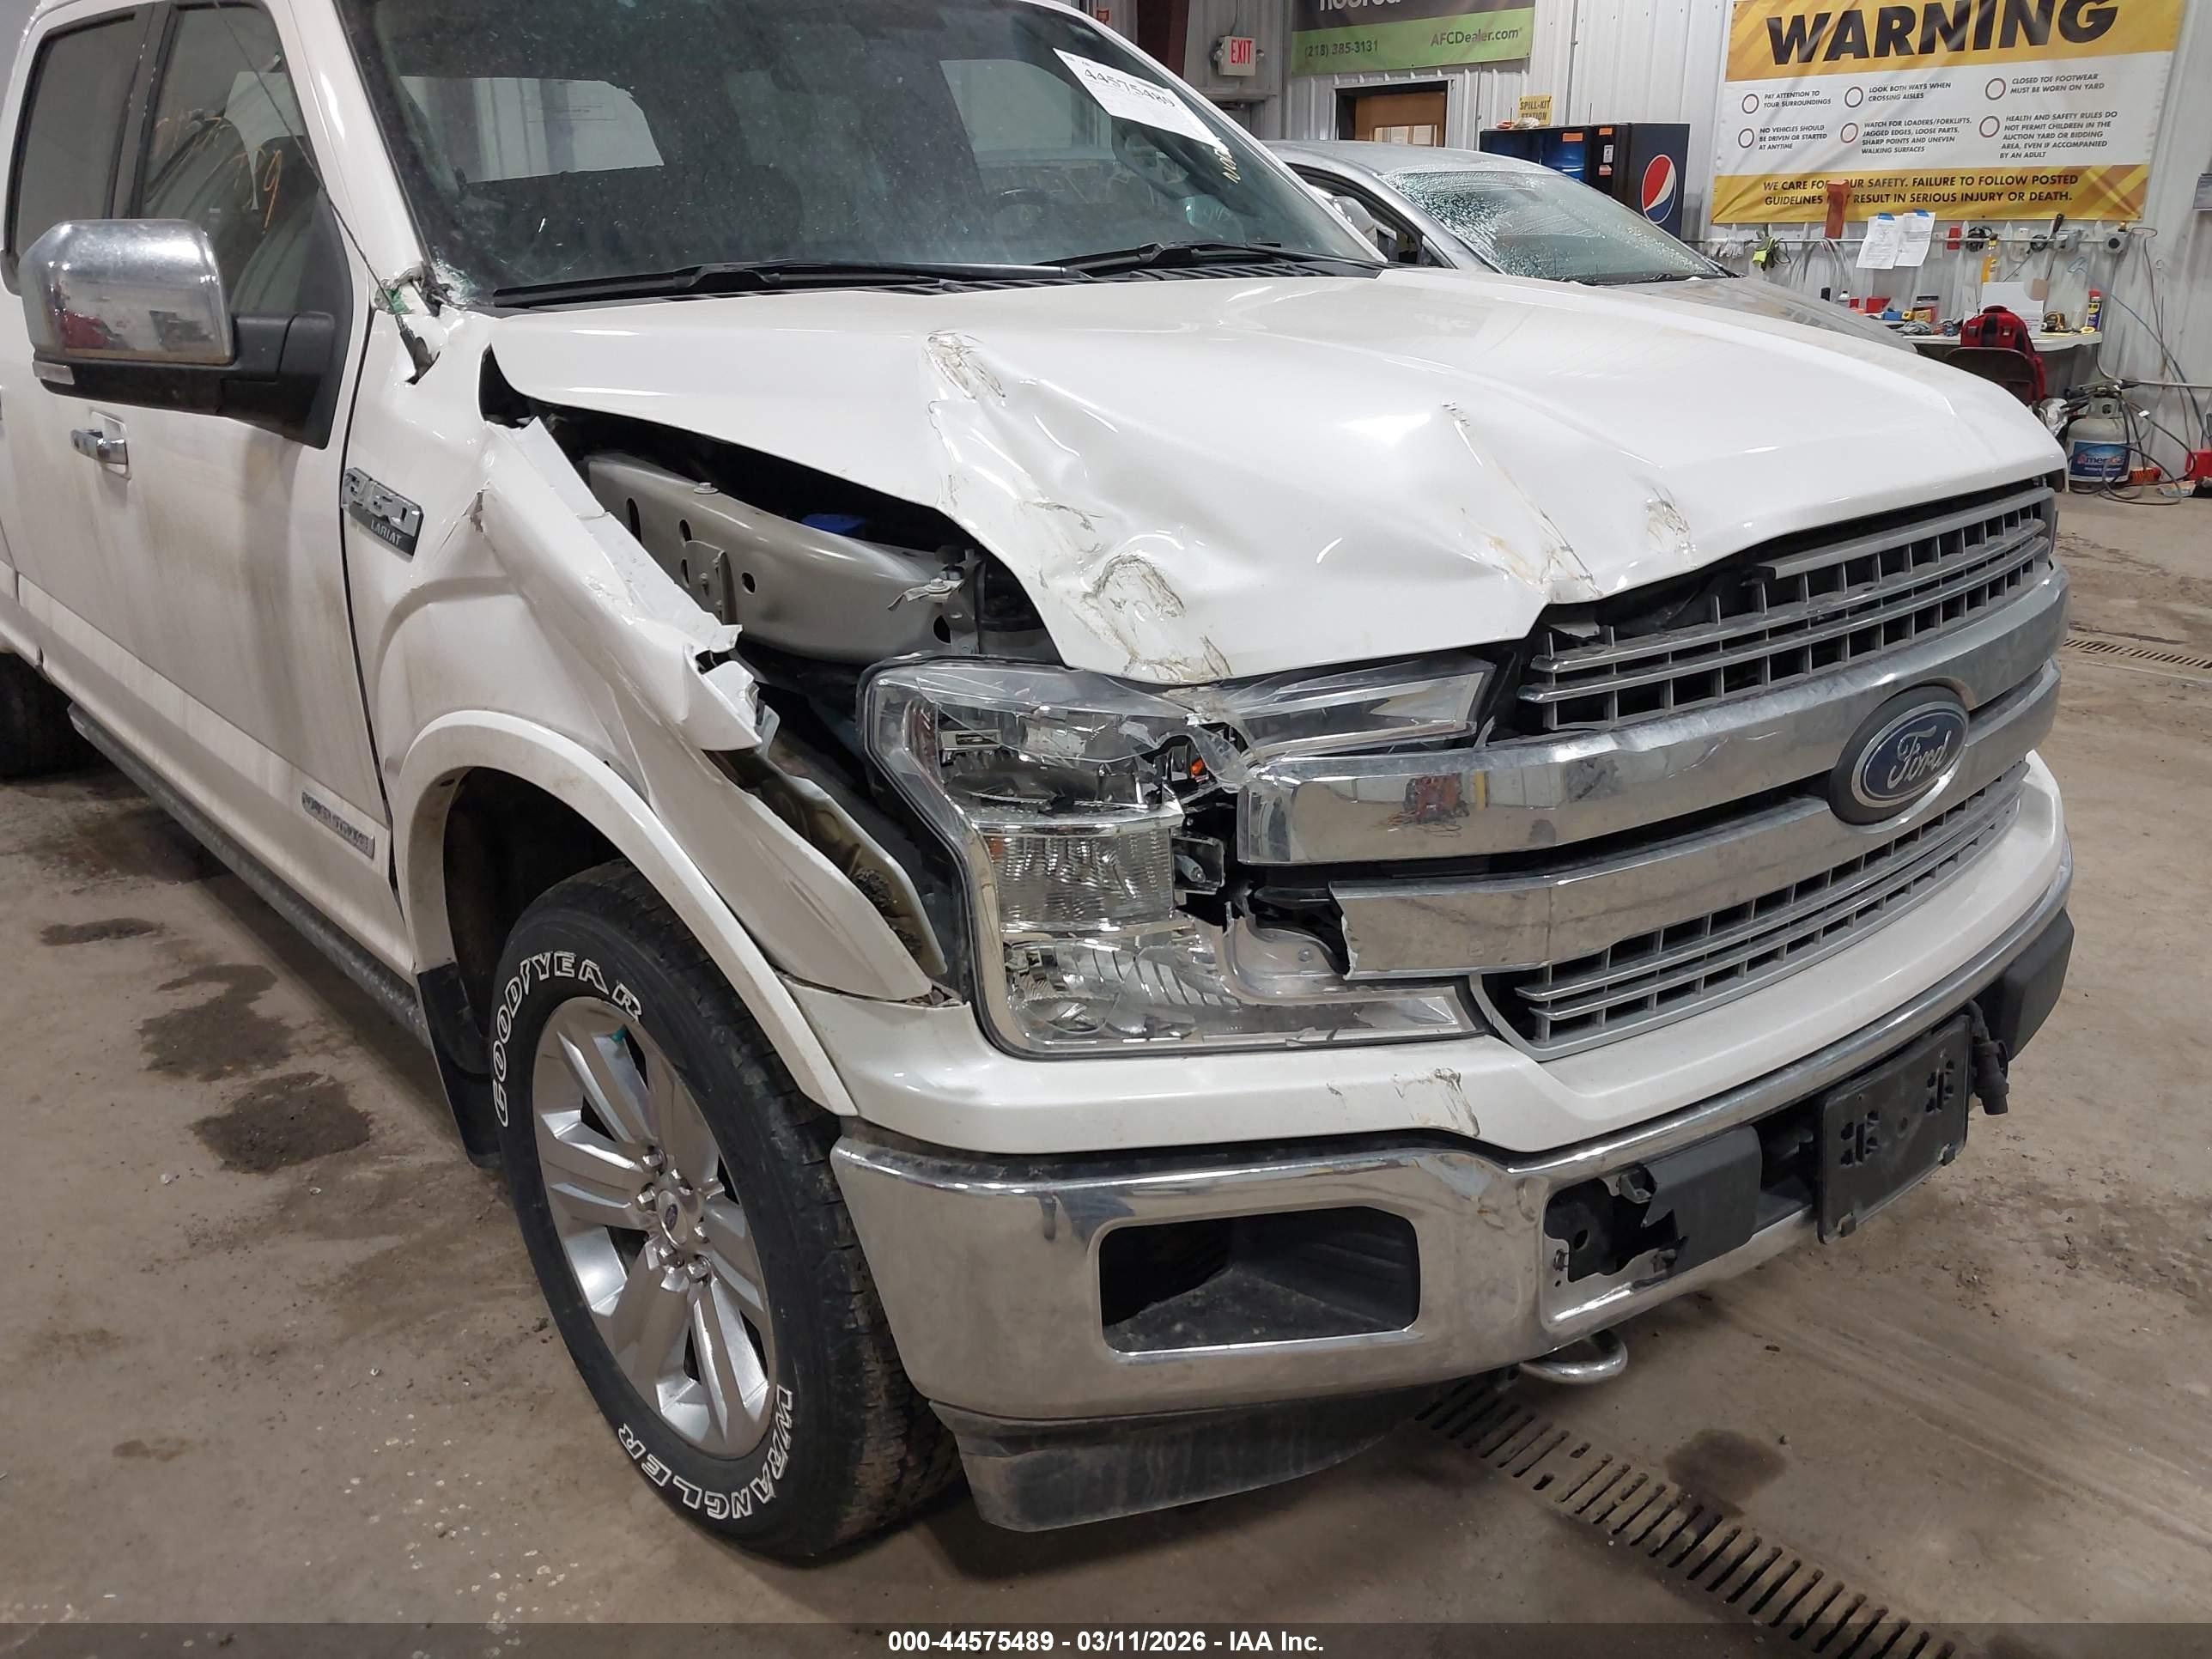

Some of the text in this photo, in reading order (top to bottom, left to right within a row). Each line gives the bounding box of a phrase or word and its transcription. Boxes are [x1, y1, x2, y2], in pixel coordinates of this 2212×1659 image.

[1431, 29, 1519, 46] AFCDealer.com
[1766, 0, 2119, 65] WARNING
[1231, 39, 1251, 64] EXIT
[1305, 40, 1378, 57] (218) 385-3131
[2055, 73, 2098, 82] FOOTWEAR
[1781, 99, 1831, 107] SURROUNDINGS
[1904, 118, 1972, 126] LOADERS/FORKLIFTS,
[1764, 182, 1779, 191] WE
[1781, 181, 1808, 190] CARE
[1868, 178, 1908, 187] SAFETY.
[1912, 176, 1956, 187] FAILURE
[1960, 176, 1974, 186] TO
[1979, 176, 2028, 185] FOLLOW
[2032, 175, 2078, 184] POSTED
[1765, 195, 1823, 205] GUIDELINES
[1854, 193, 1892, 203] RESULT
[1894, 193, 1906, 202] IN
[1910, 193, 1957, 203] SERIOUS
[1961, 192, 2004, 201] INJURY
[2008, 192, 2025, 201] OR
[2029, 191, 2072, 201] DEATH.
[371, 519, 403, 545] LARIAT
[1887, 725, 1952, 789] Ford
[491, 951, 642, 1127] GOODYEAR
[618, 1384, 793, 1520] WRANGLER
